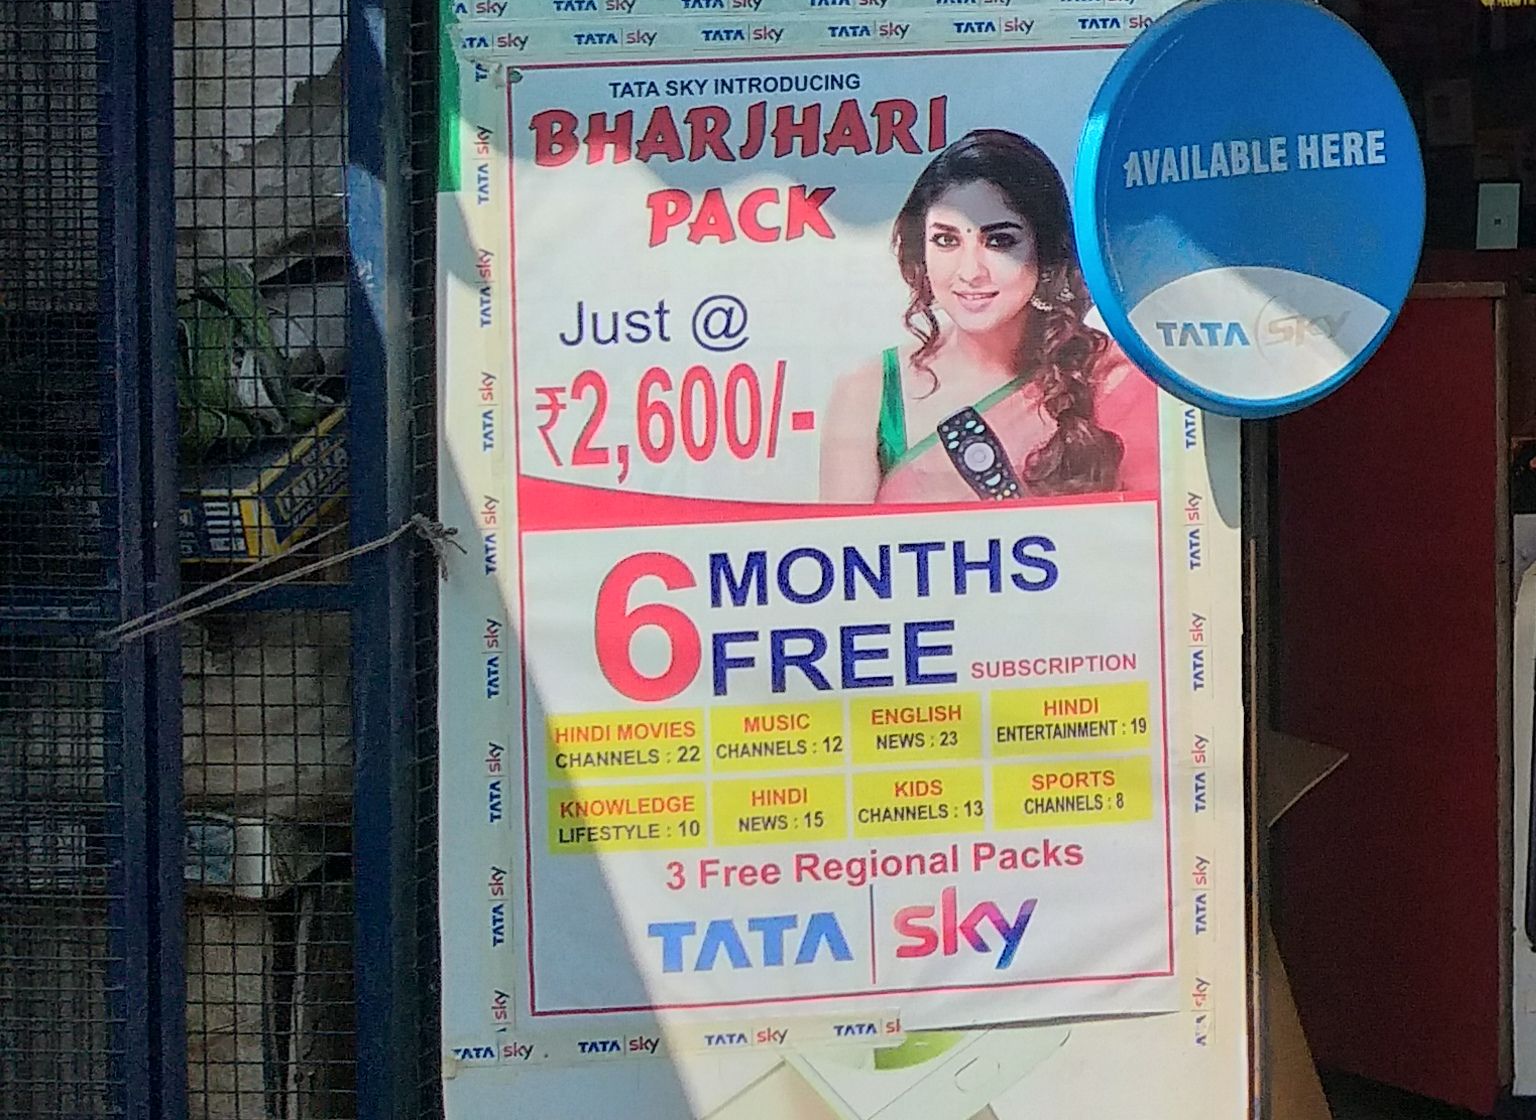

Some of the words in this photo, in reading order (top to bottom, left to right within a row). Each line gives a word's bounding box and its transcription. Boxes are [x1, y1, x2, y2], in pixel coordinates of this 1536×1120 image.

[553, 0, 597, 12] TATA
[574, 33, 618, 45] TATA
[626, 30, 657, 47] sky
[829, 24, 871, 37] TATA
[879, 21, 910, 39] sky
[609, 81, 658, 99] TATA
[665, 79, 707, 97] SKY
[714, 73, 861, 95] INTRODUCING
[528, 93, 948, 168] BHARJHARI
[1122, 136, 1288, 188] AVAILABLE
[1298, 130, 1386, 171] HERE
[646, 184, 836, 248] PACK
[558, 297, 672, 347] Just
[691, 295, 750, 352] @
[1156, 321, 1250, 347] TATA
[594, 551, 702, 703] 6
[709, 535, 1060, 611] MONTHS
[711, 619, 959, 696] FREE
[971, 653, 1137, 679] SUBSCRIPTION
[871, 705, 962, 725] ENGLISH
[1043, 697, 1099, 716] HINDI
[556, 725, 611, 744] HINDI
[617, 721, 696, 740] MOVIES
[744, 713, 810, 733] MUSIC
[997, 719, 1118, 743] ENTERTAINMENT
[1130, 717, 1147, 734] 19
[716, 739, 807, 759] CHANNELS
[823, 735, 843, 753] 12
[876, 733, 925, 750] NEWS
[939, 730, 958, 746] 23
[556, 749, 660, 769] CHANNELS
[677, 745, 700, 764] 22
[894, 779, 943, 797] KIDS
[1031, 770, 1116, 791] SPORTS
[560, 795, 695, 819] KNOWLEDGE
[752, 787, 808, 807] HINDI
[1024, 794, 1103, 815] CHANNELS
[1115, 792, 1125, 809] 8
[739, 815, 788, 832] NEWS
[804, 811, 824, 828] 15
[858, 804, 949, 824] CHANNELS
[964, 800, 984, 817] 13
[559, 823, 660, 844] LIFESTYLE
[679, 820, 700, 838] 10
[666, 862, 686, 890] 3
[699, 856, 781, 888] Free
[794, 845, 959, 890] Regional
[973, 840, 1084, 873] Packs
[647, 911, 854, 974] TATA
[896, 886, 1038, 971] sky
[577, 1040, 621, 1053] TATA
[629, 1036, 660, 1055] sky
